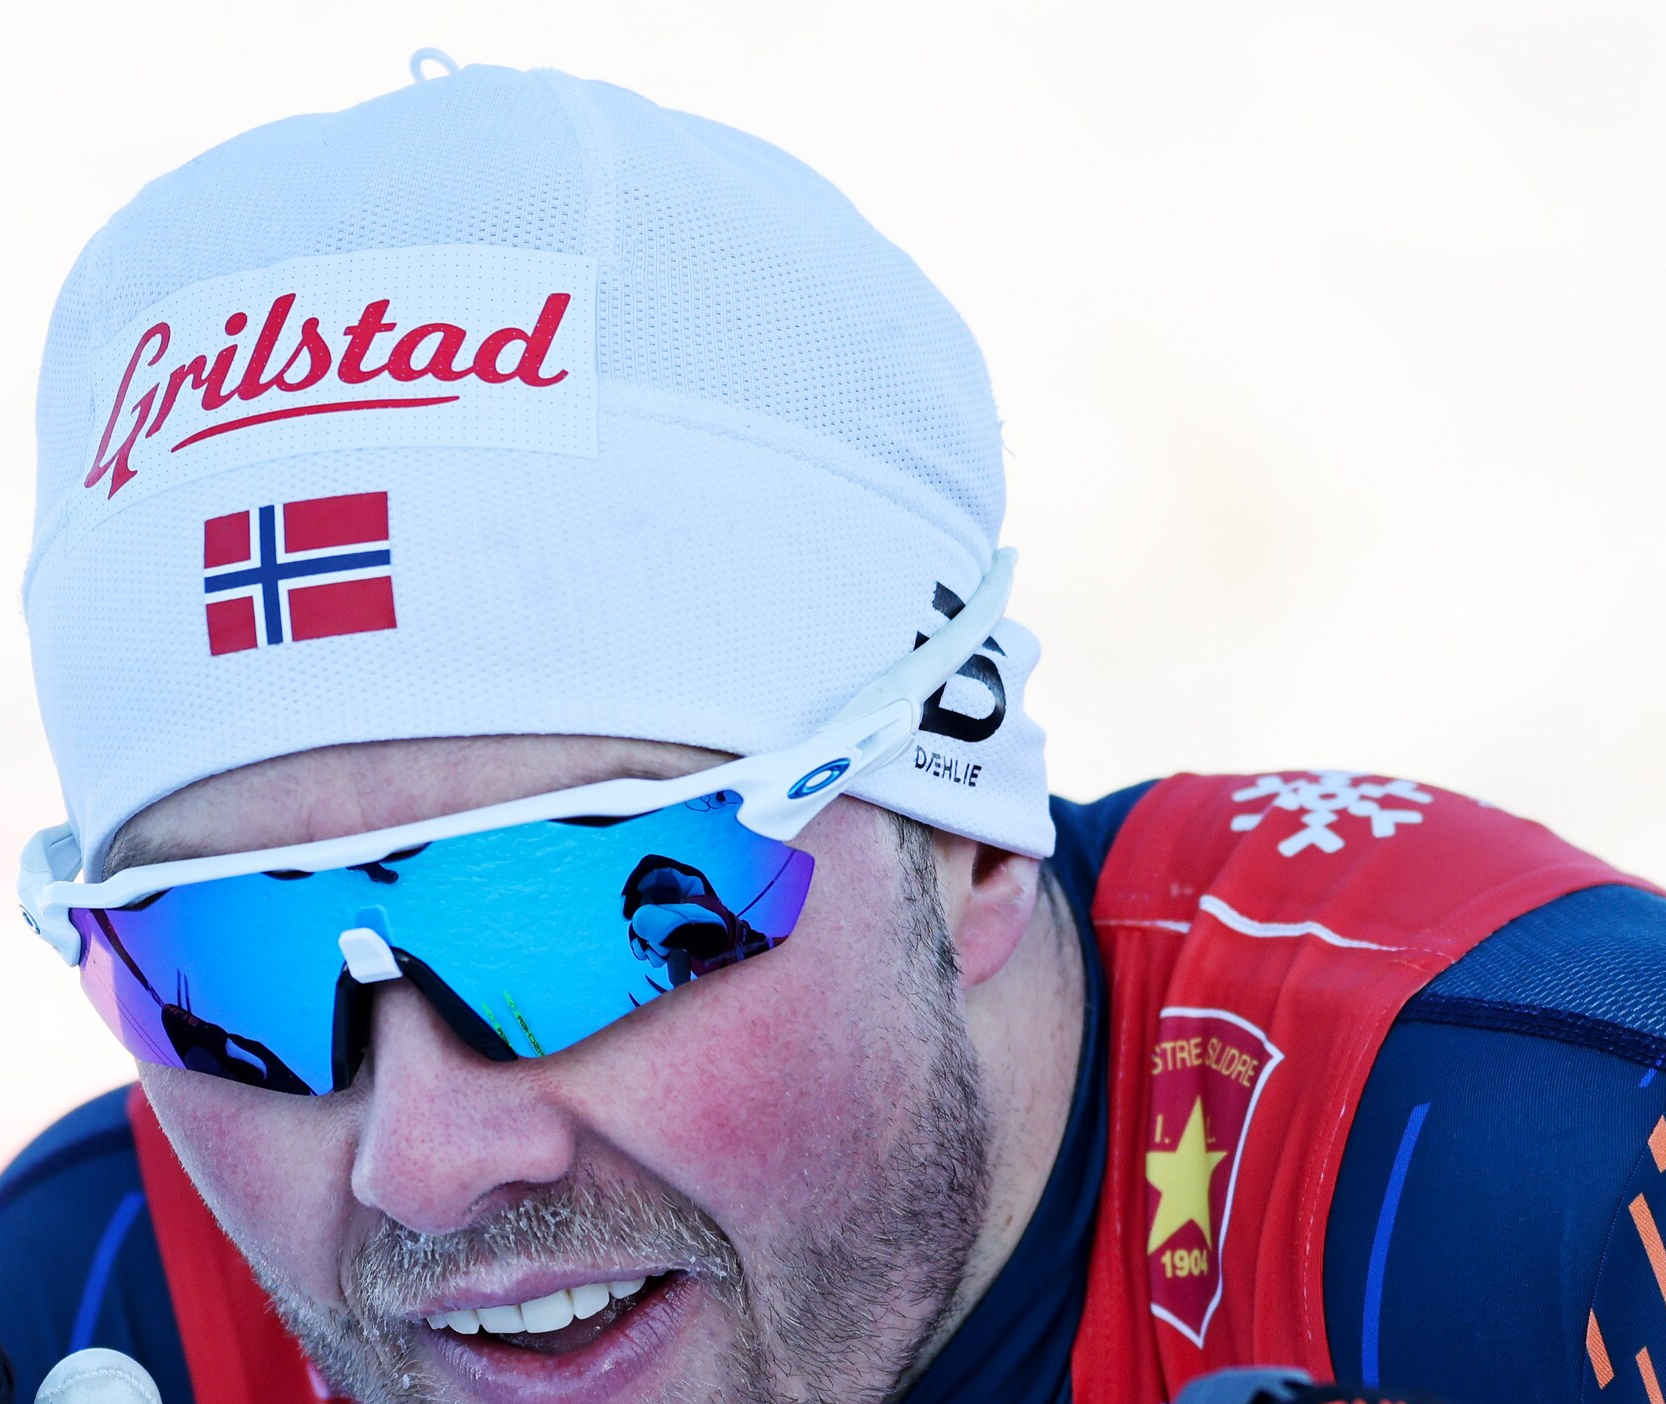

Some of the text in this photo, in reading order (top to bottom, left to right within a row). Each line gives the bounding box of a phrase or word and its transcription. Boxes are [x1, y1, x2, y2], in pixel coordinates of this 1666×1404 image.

[84, 293, 571, 499] Grilstad
[1205, 1037, 1259, 1088] SLIDRE
[1161, 1248, 1209, 1280] 1904
